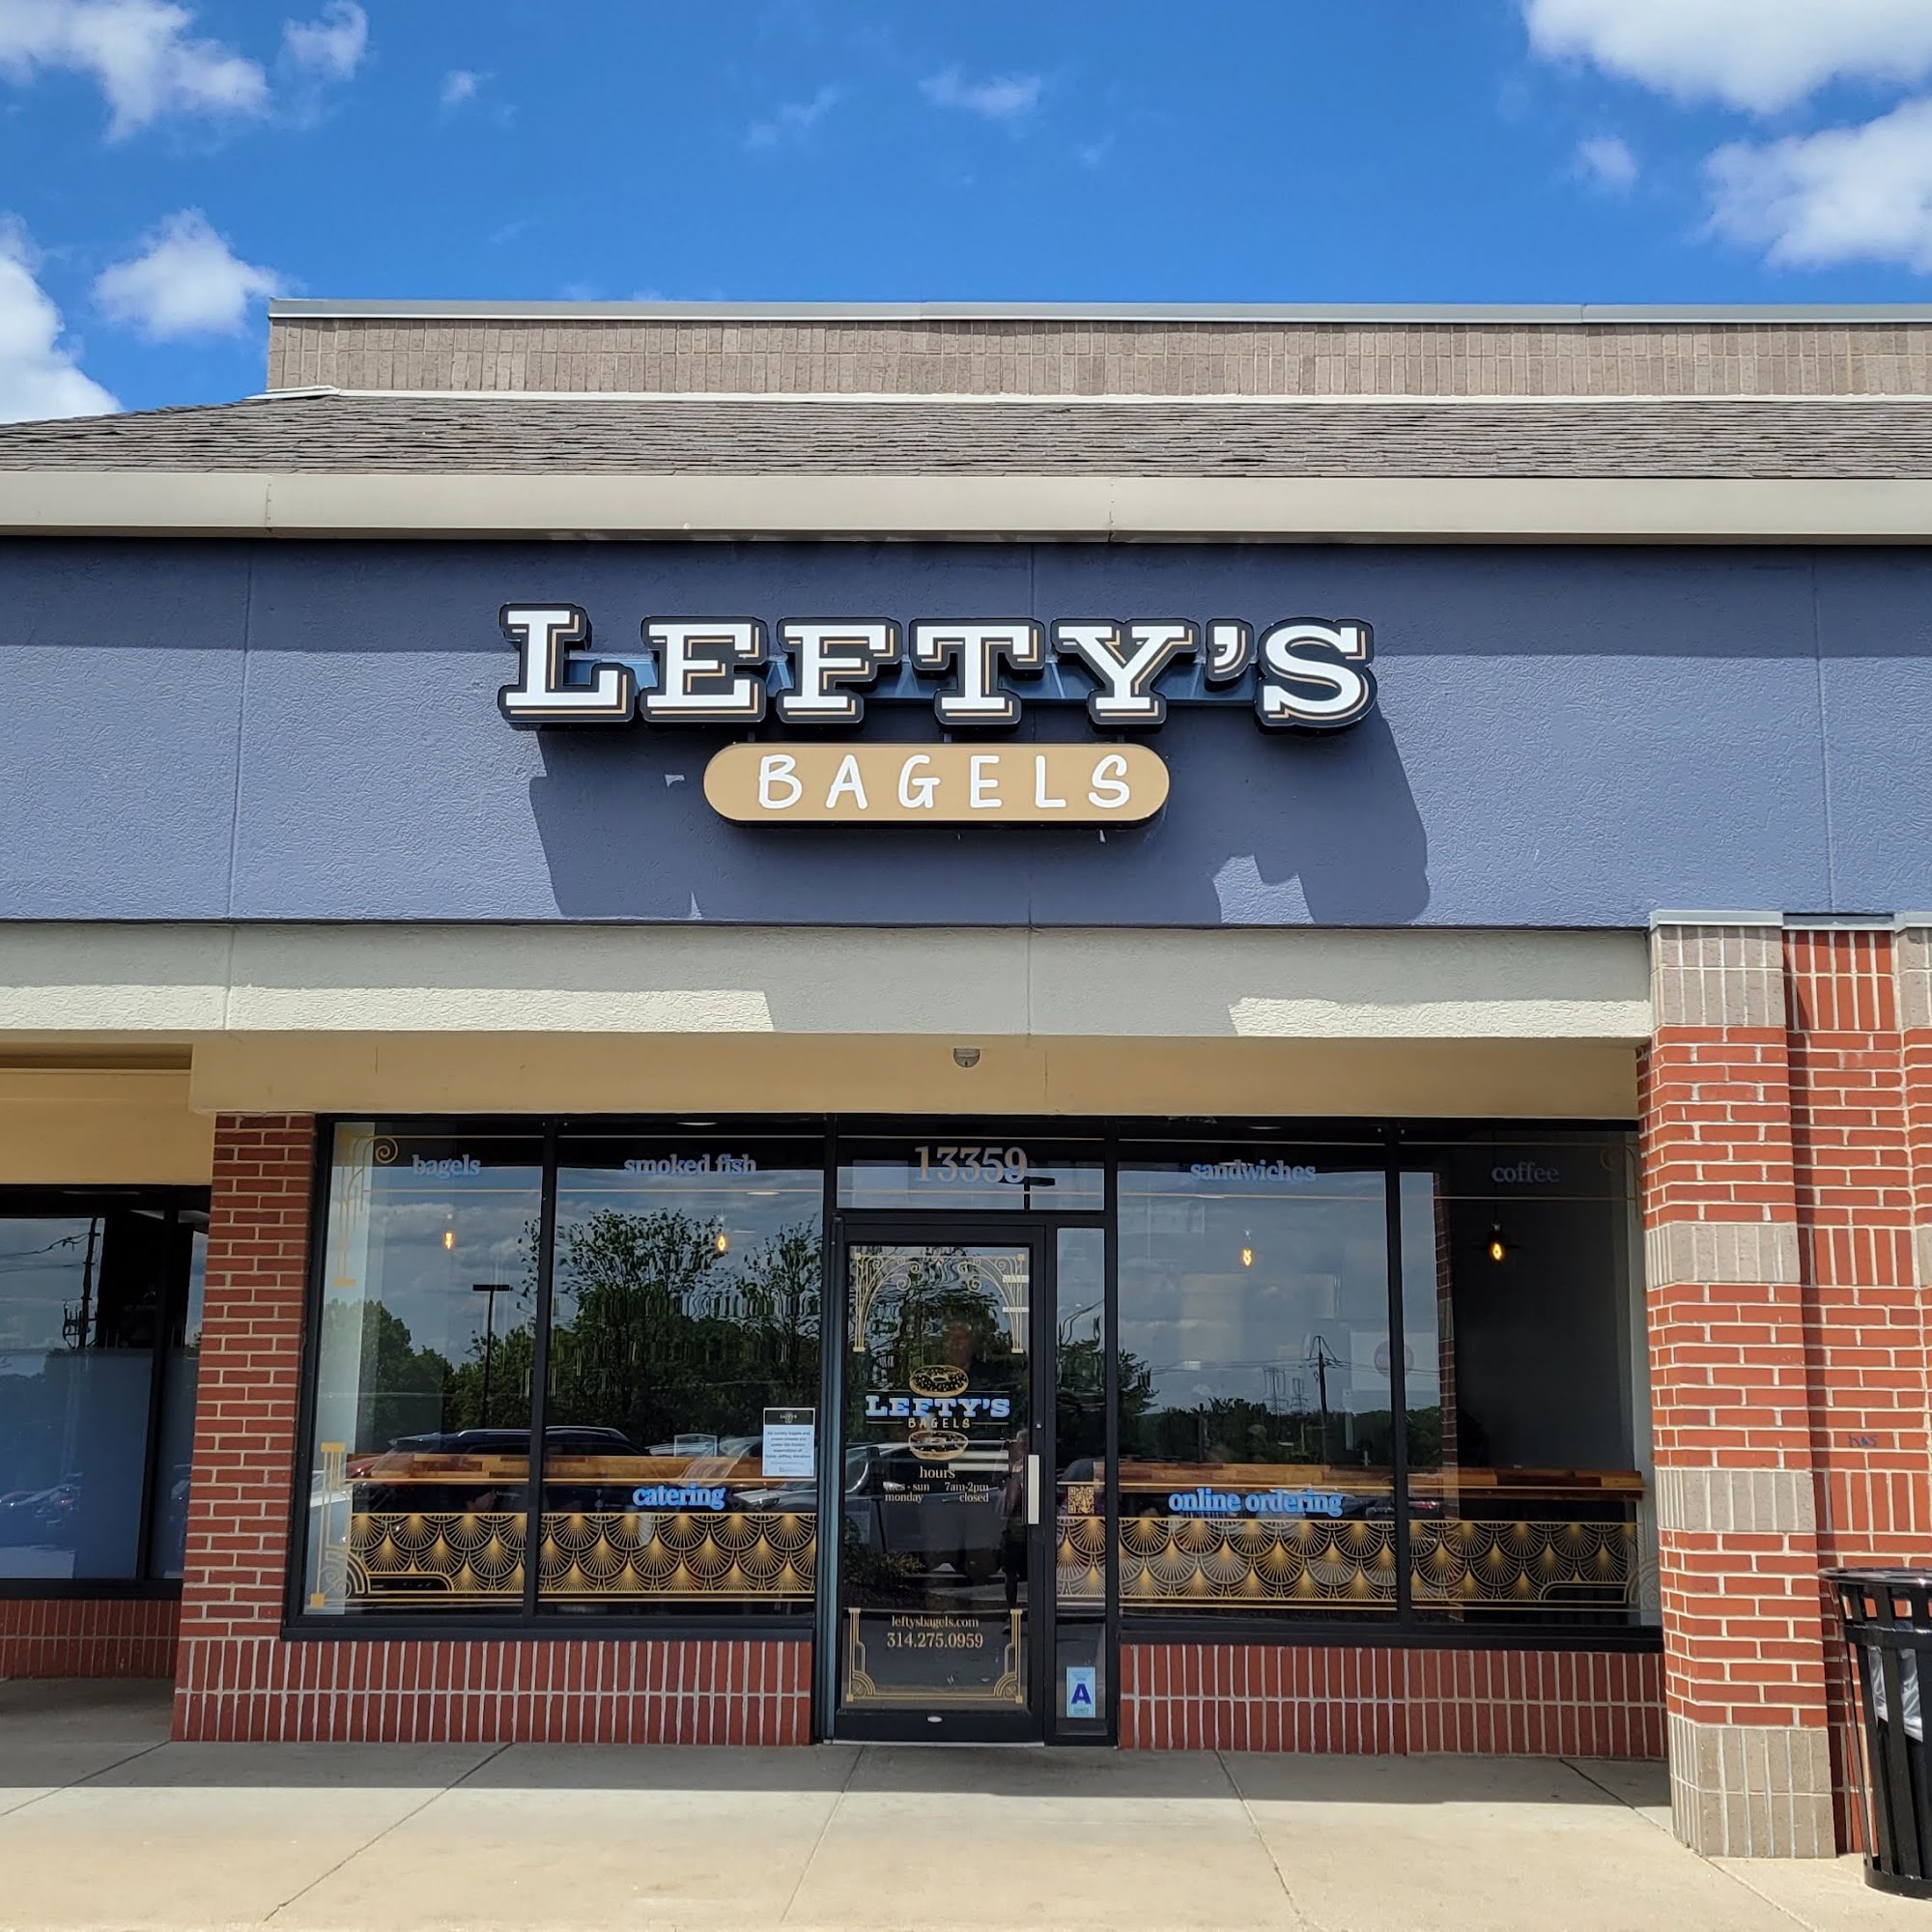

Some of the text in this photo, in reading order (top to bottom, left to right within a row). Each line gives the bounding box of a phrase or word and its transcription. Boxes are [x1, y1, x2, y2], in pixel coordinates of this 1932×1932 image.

[501, 609, 1370, 721] LEFTY'S
[757, 754, 1131, 810] BAGELS
[412, 1154, 482, 1179] bagels
[623, 1153, 757, 1176] smoked fish
[914, 1146, 1028, 1183] 13359
[1189, 1159, 1317, 1182] sandwiches
[1491, 1160, 1559, 1183] coffee
[865, 1395, 1010, 1418] LEFTY'S
[908, 1417, 971, 1429] BAGELS
[919, 1465, 956, 1479] hours
[632, 1483, 726, 1511] catering
[885, 1492, 989, 1504] monday closed
[912, 1483, 930, 1492] sun
[1168, 1488, 1344, 1518] online ordering
[891, 1614, 980, 1630] leftysbagels.com
[887, 1632, 984, 1648] 314.275.0959
[1070, 1683, 1093, 1705] A
